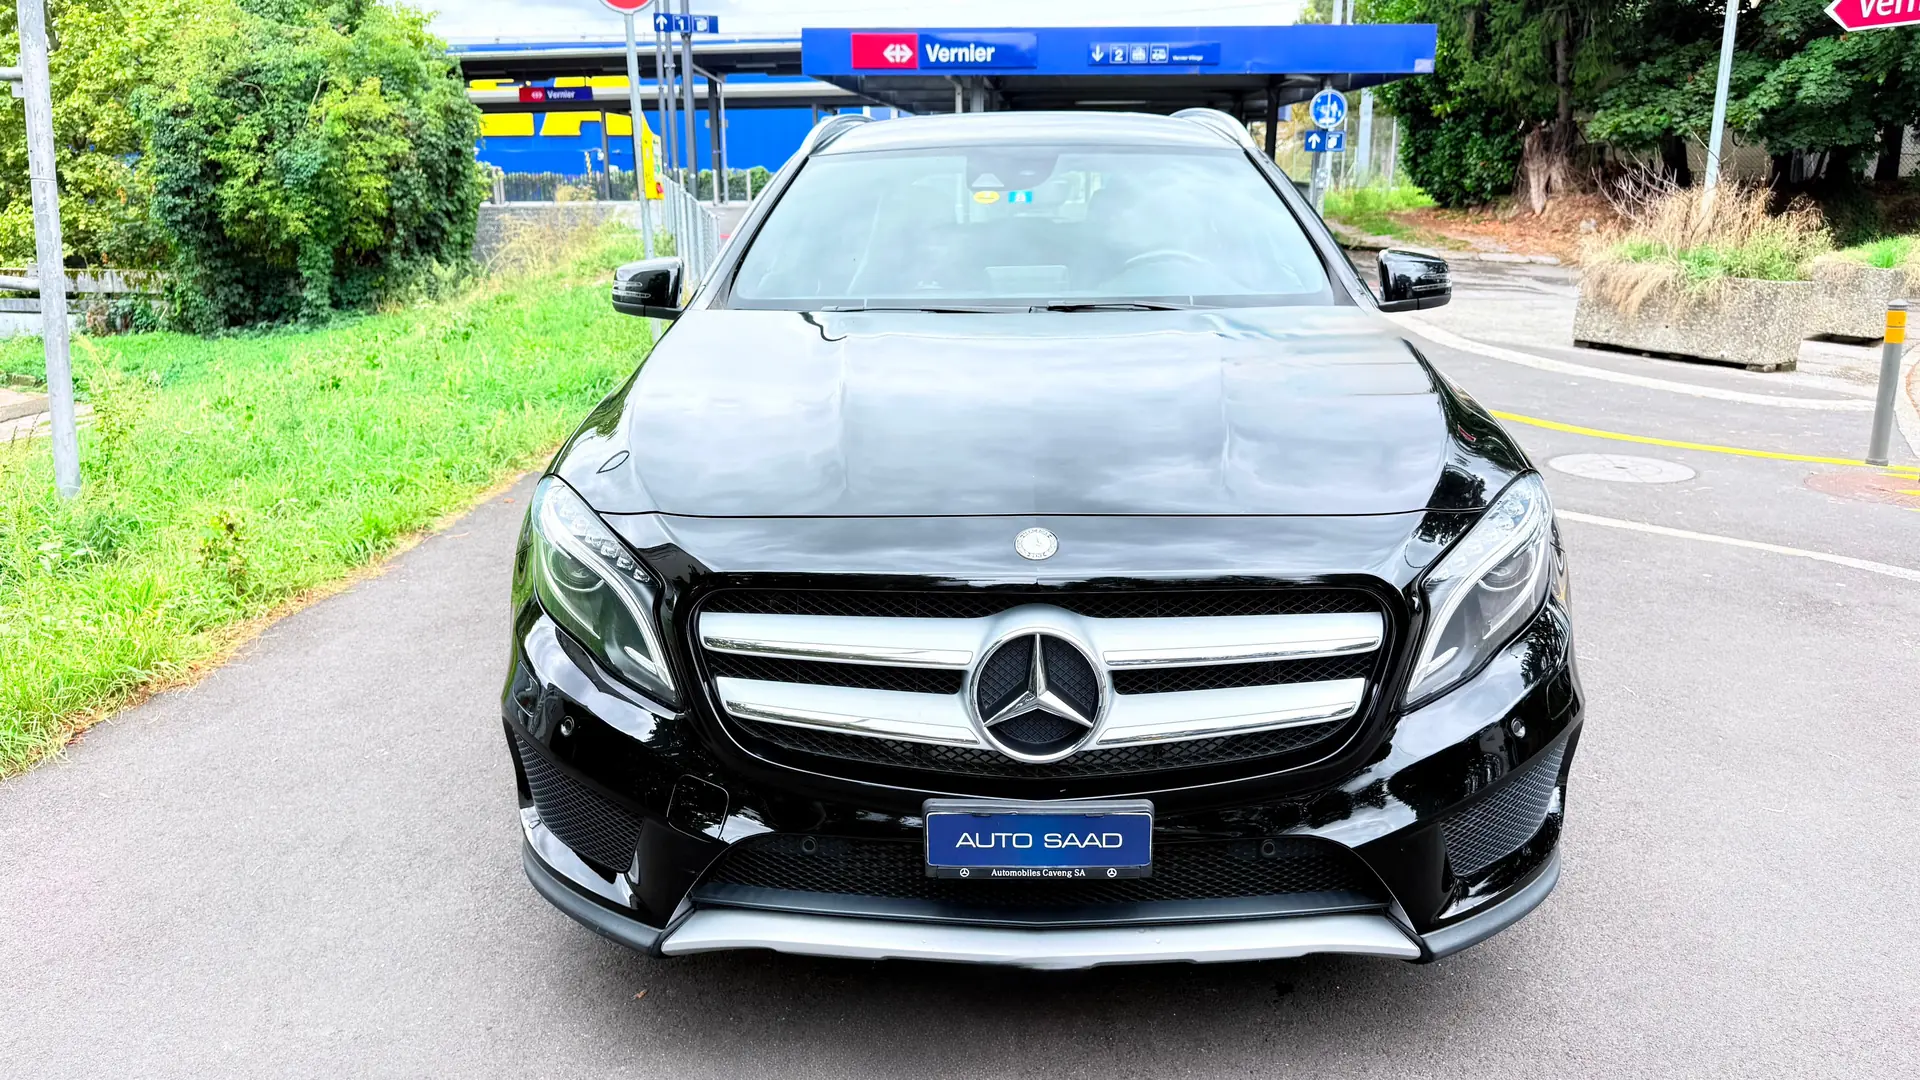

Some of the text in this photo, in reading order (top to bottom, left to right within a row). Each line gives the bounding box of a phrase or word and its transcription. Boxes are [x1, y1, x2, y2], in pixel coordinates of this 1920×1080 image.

[925, 43, 996, 63] Vernier
[1114, 49, 1124, 62] 2
[547, 90, 576, 99] Vernier
[955, 832, 1123, 849] AUTO SAAD
[991, 868, 1086, 879] Automobiles Caveng SA
